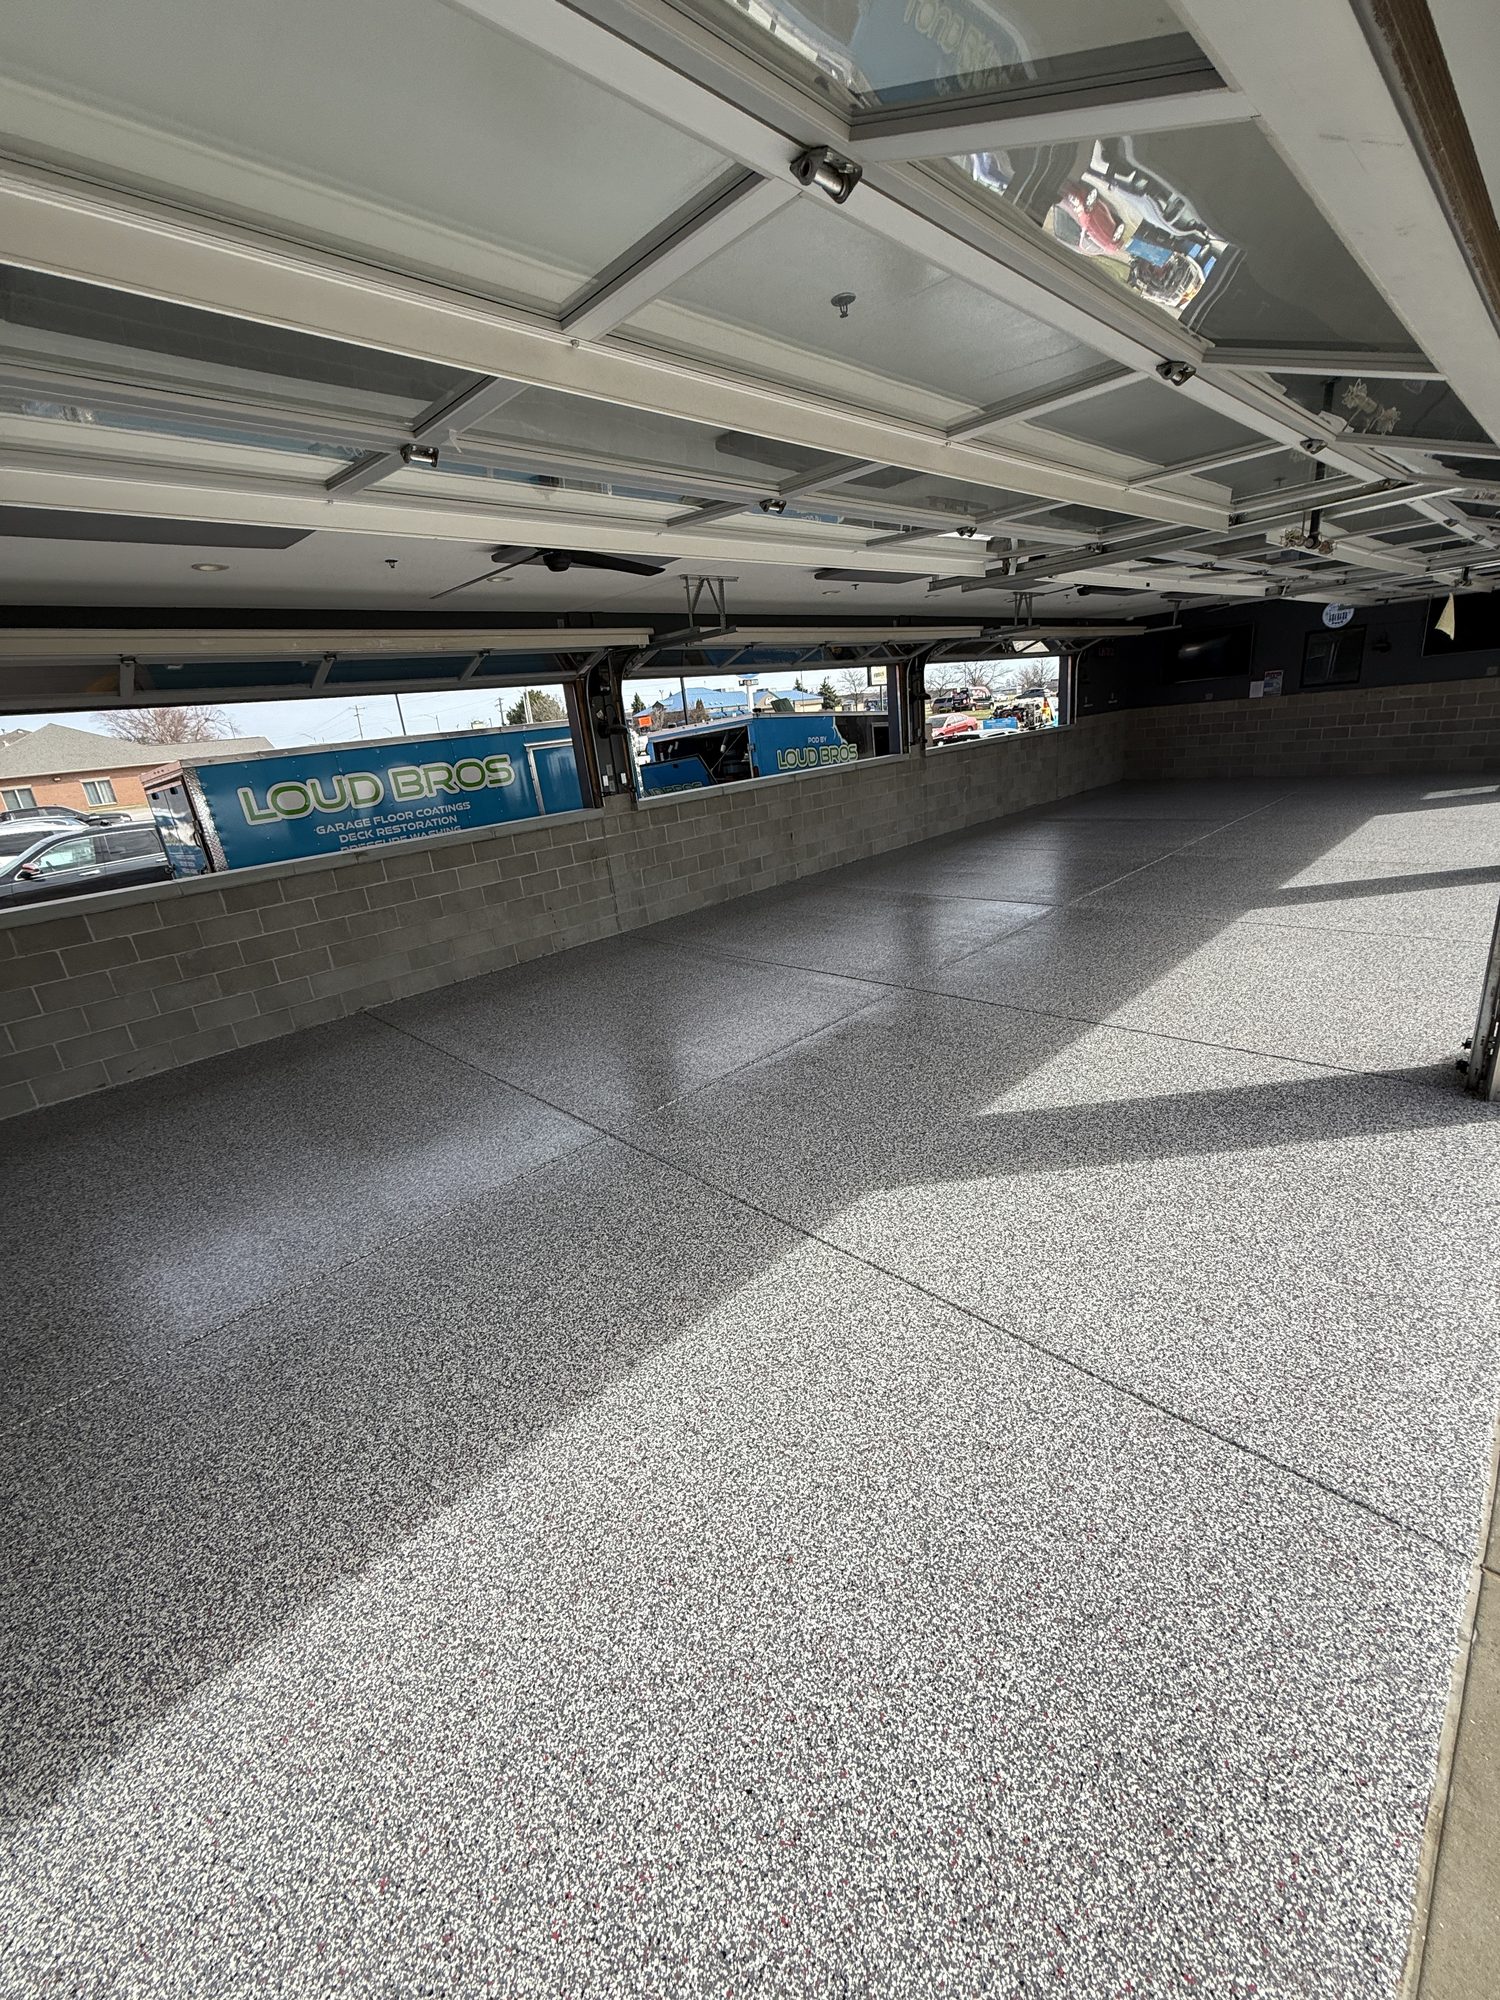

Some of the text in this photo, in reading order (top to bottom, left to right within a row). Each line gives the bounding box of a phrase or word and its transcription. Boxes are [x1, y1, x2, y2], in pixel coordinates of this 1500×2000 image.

[777, 744, 858, 770] LOUD BROS
[238, 754, 516, 826] LOUD BROS
[315, 801, 471, 835] GARAGE FLOOR COATINGS
[338, 814, 458, 843] DECK RESTORATION
